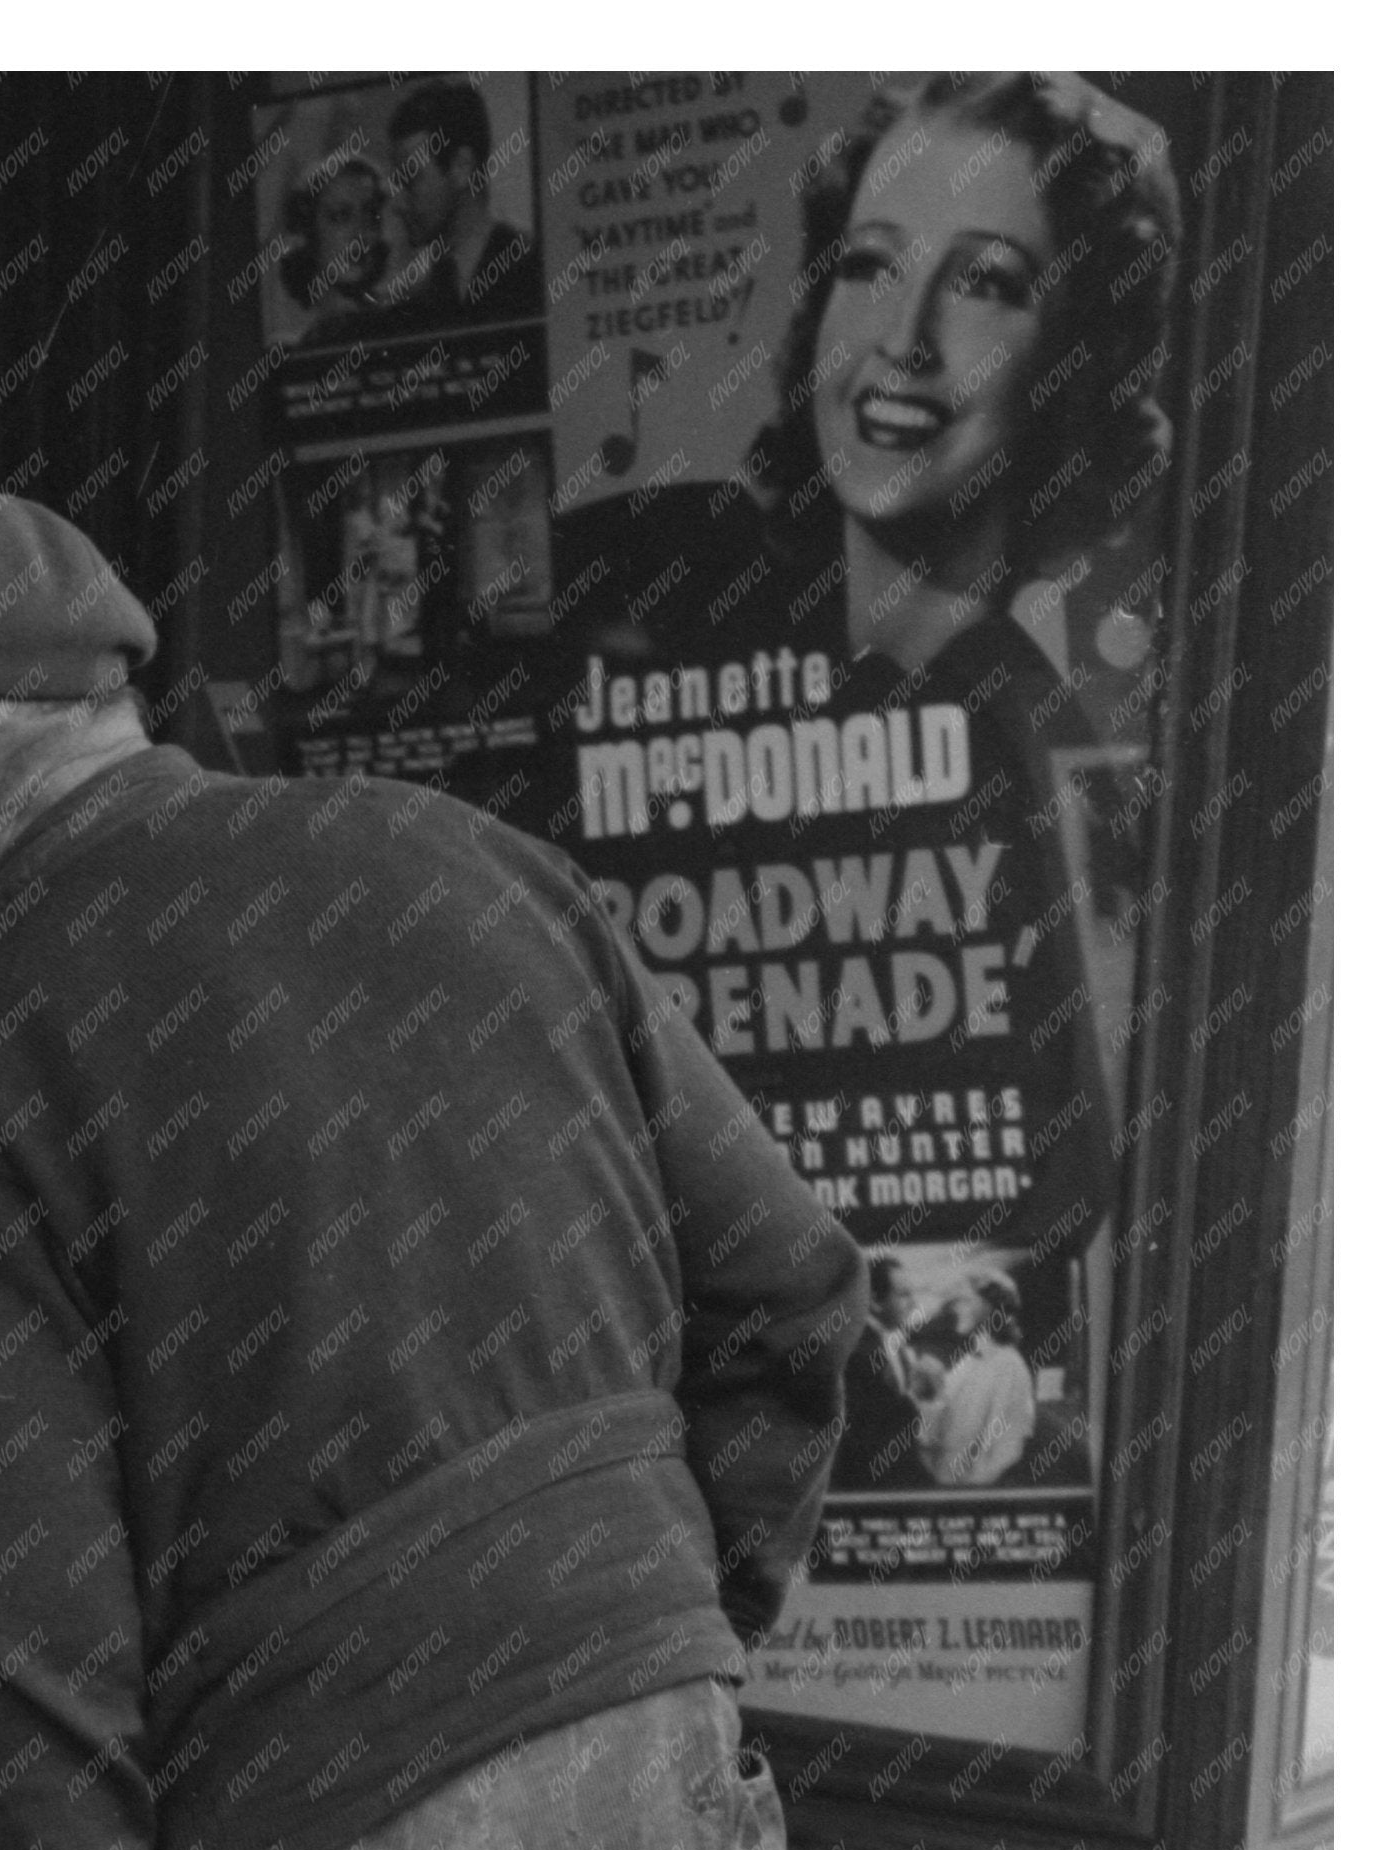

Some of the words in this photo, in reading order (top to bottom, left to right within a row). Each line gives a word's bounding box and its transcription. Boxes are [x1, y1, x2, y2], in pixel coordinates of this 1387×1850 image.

[698, 108, 761, 143] WHO
[578, 173, 651, 209] GAVE
[650, 245, 743, 287] GREAT
[576, 647, 831, 733] Jeanette
[594, 844, 1004, 960] ROADWAY
[773, 1100, 838, 1135] EW
[861, 1087, 1022, 1130] AYRES
[845, 1127, 1024, 1167] HUNTER
[834, 1617, 927, 1649] ROBERT
[962, 1617, 1082, 1649] LEONARD
